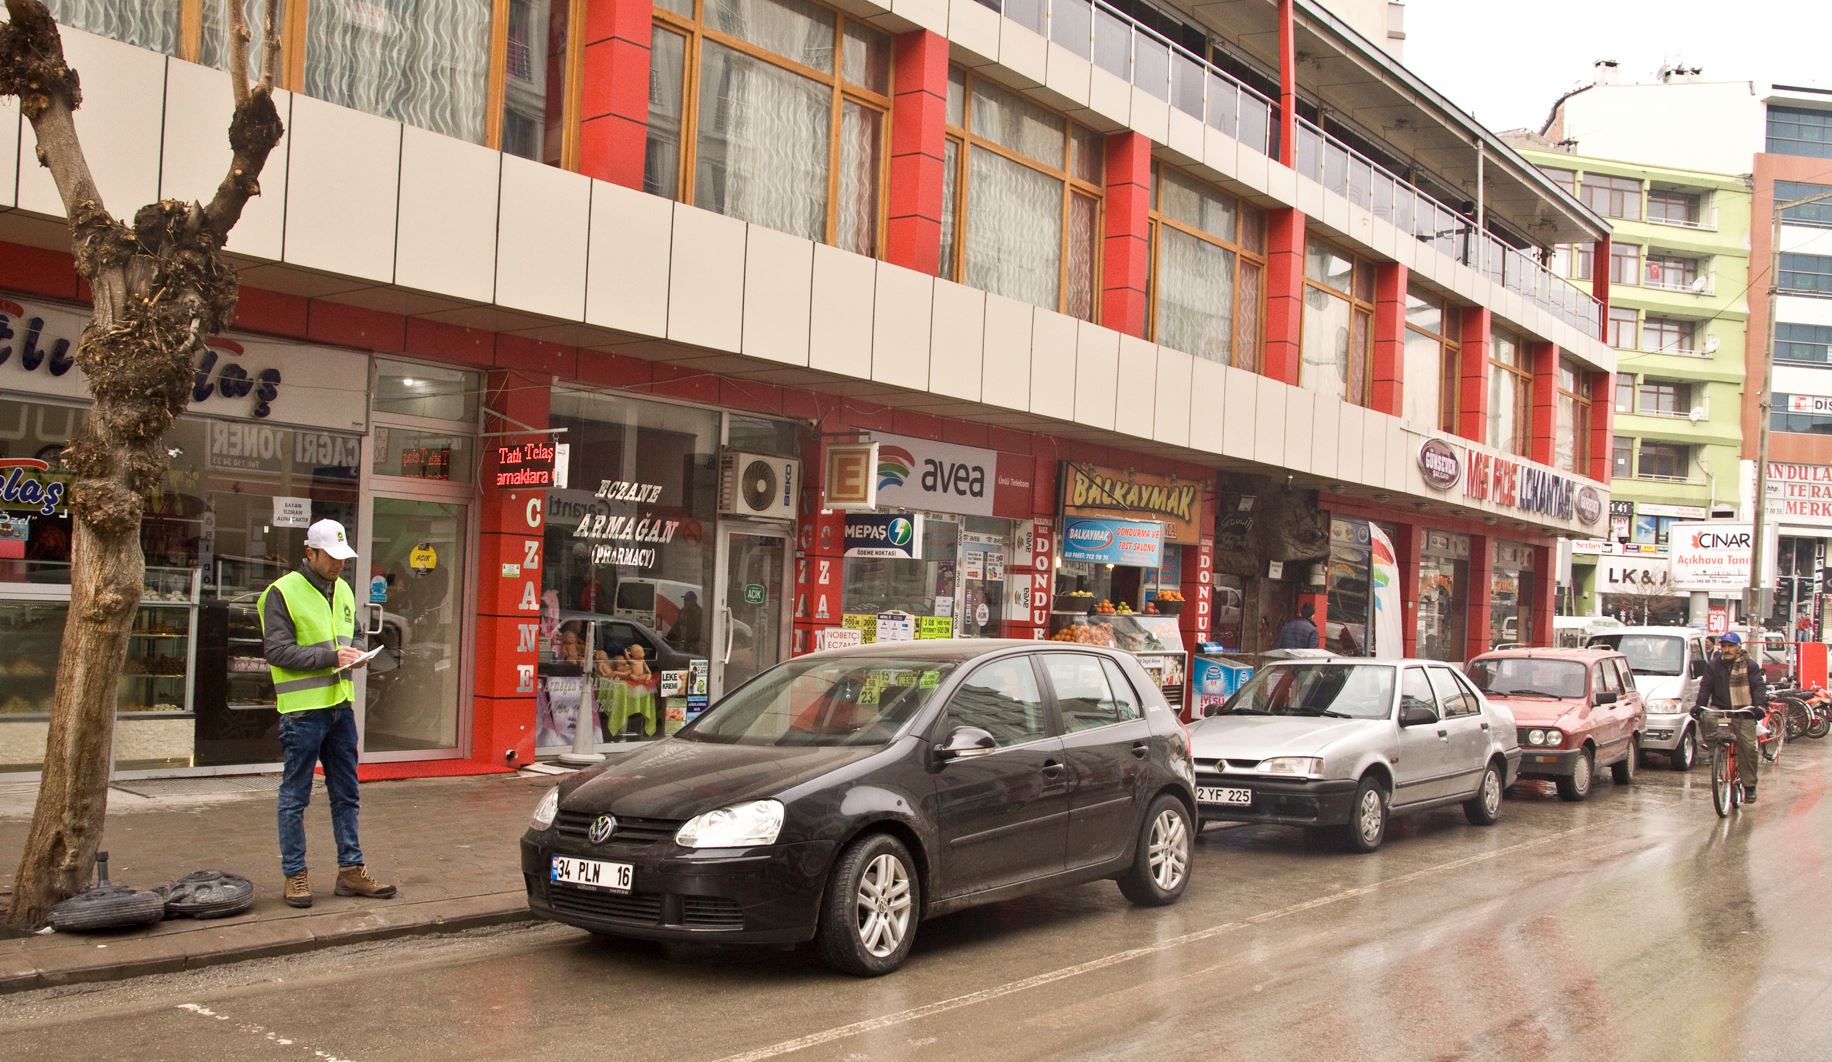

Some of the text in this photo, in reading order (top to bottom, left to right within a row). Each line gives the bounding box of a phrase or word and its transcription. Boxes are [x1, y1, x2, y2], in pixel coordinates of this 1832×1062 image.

[525, 442, 553, 462] Telaş
[784, 463, 792, 507] BEKO
[921, 458, 985, 498] avea
[594, 479, 662, 503] ECZANE
[1073, 470, 1195, 521] BALKAYMAK
[572, 511, 680, 544] ARMAĞAN
[844, 524, 887, 541] MEPAŞ
[1069, 528, 1109, 542] BALKAYMAK
[1116, 527, 1160, 539] DONDURMA VE
[1119, 541, 1132, 551] TOST
[591, 543, 656, 568] (PHARMACY)
[1677, 554, 1751, 566] Açıkhava Tanı
[516, 498, 542, 693] CZANE
[747, 589, 762, 600] AÇIK
[1033, 537, 1049, 640] DONDUR
[1710, 614, 1725, 630] 50
[662, 673, 678, 681] LEKE
[861, 691, 873, 704] 23
[1208, 788, 1224, 801] YF
[1228, 790, 1250, 803] 225
[558, 859, 631, 887] 34 PLN 16
